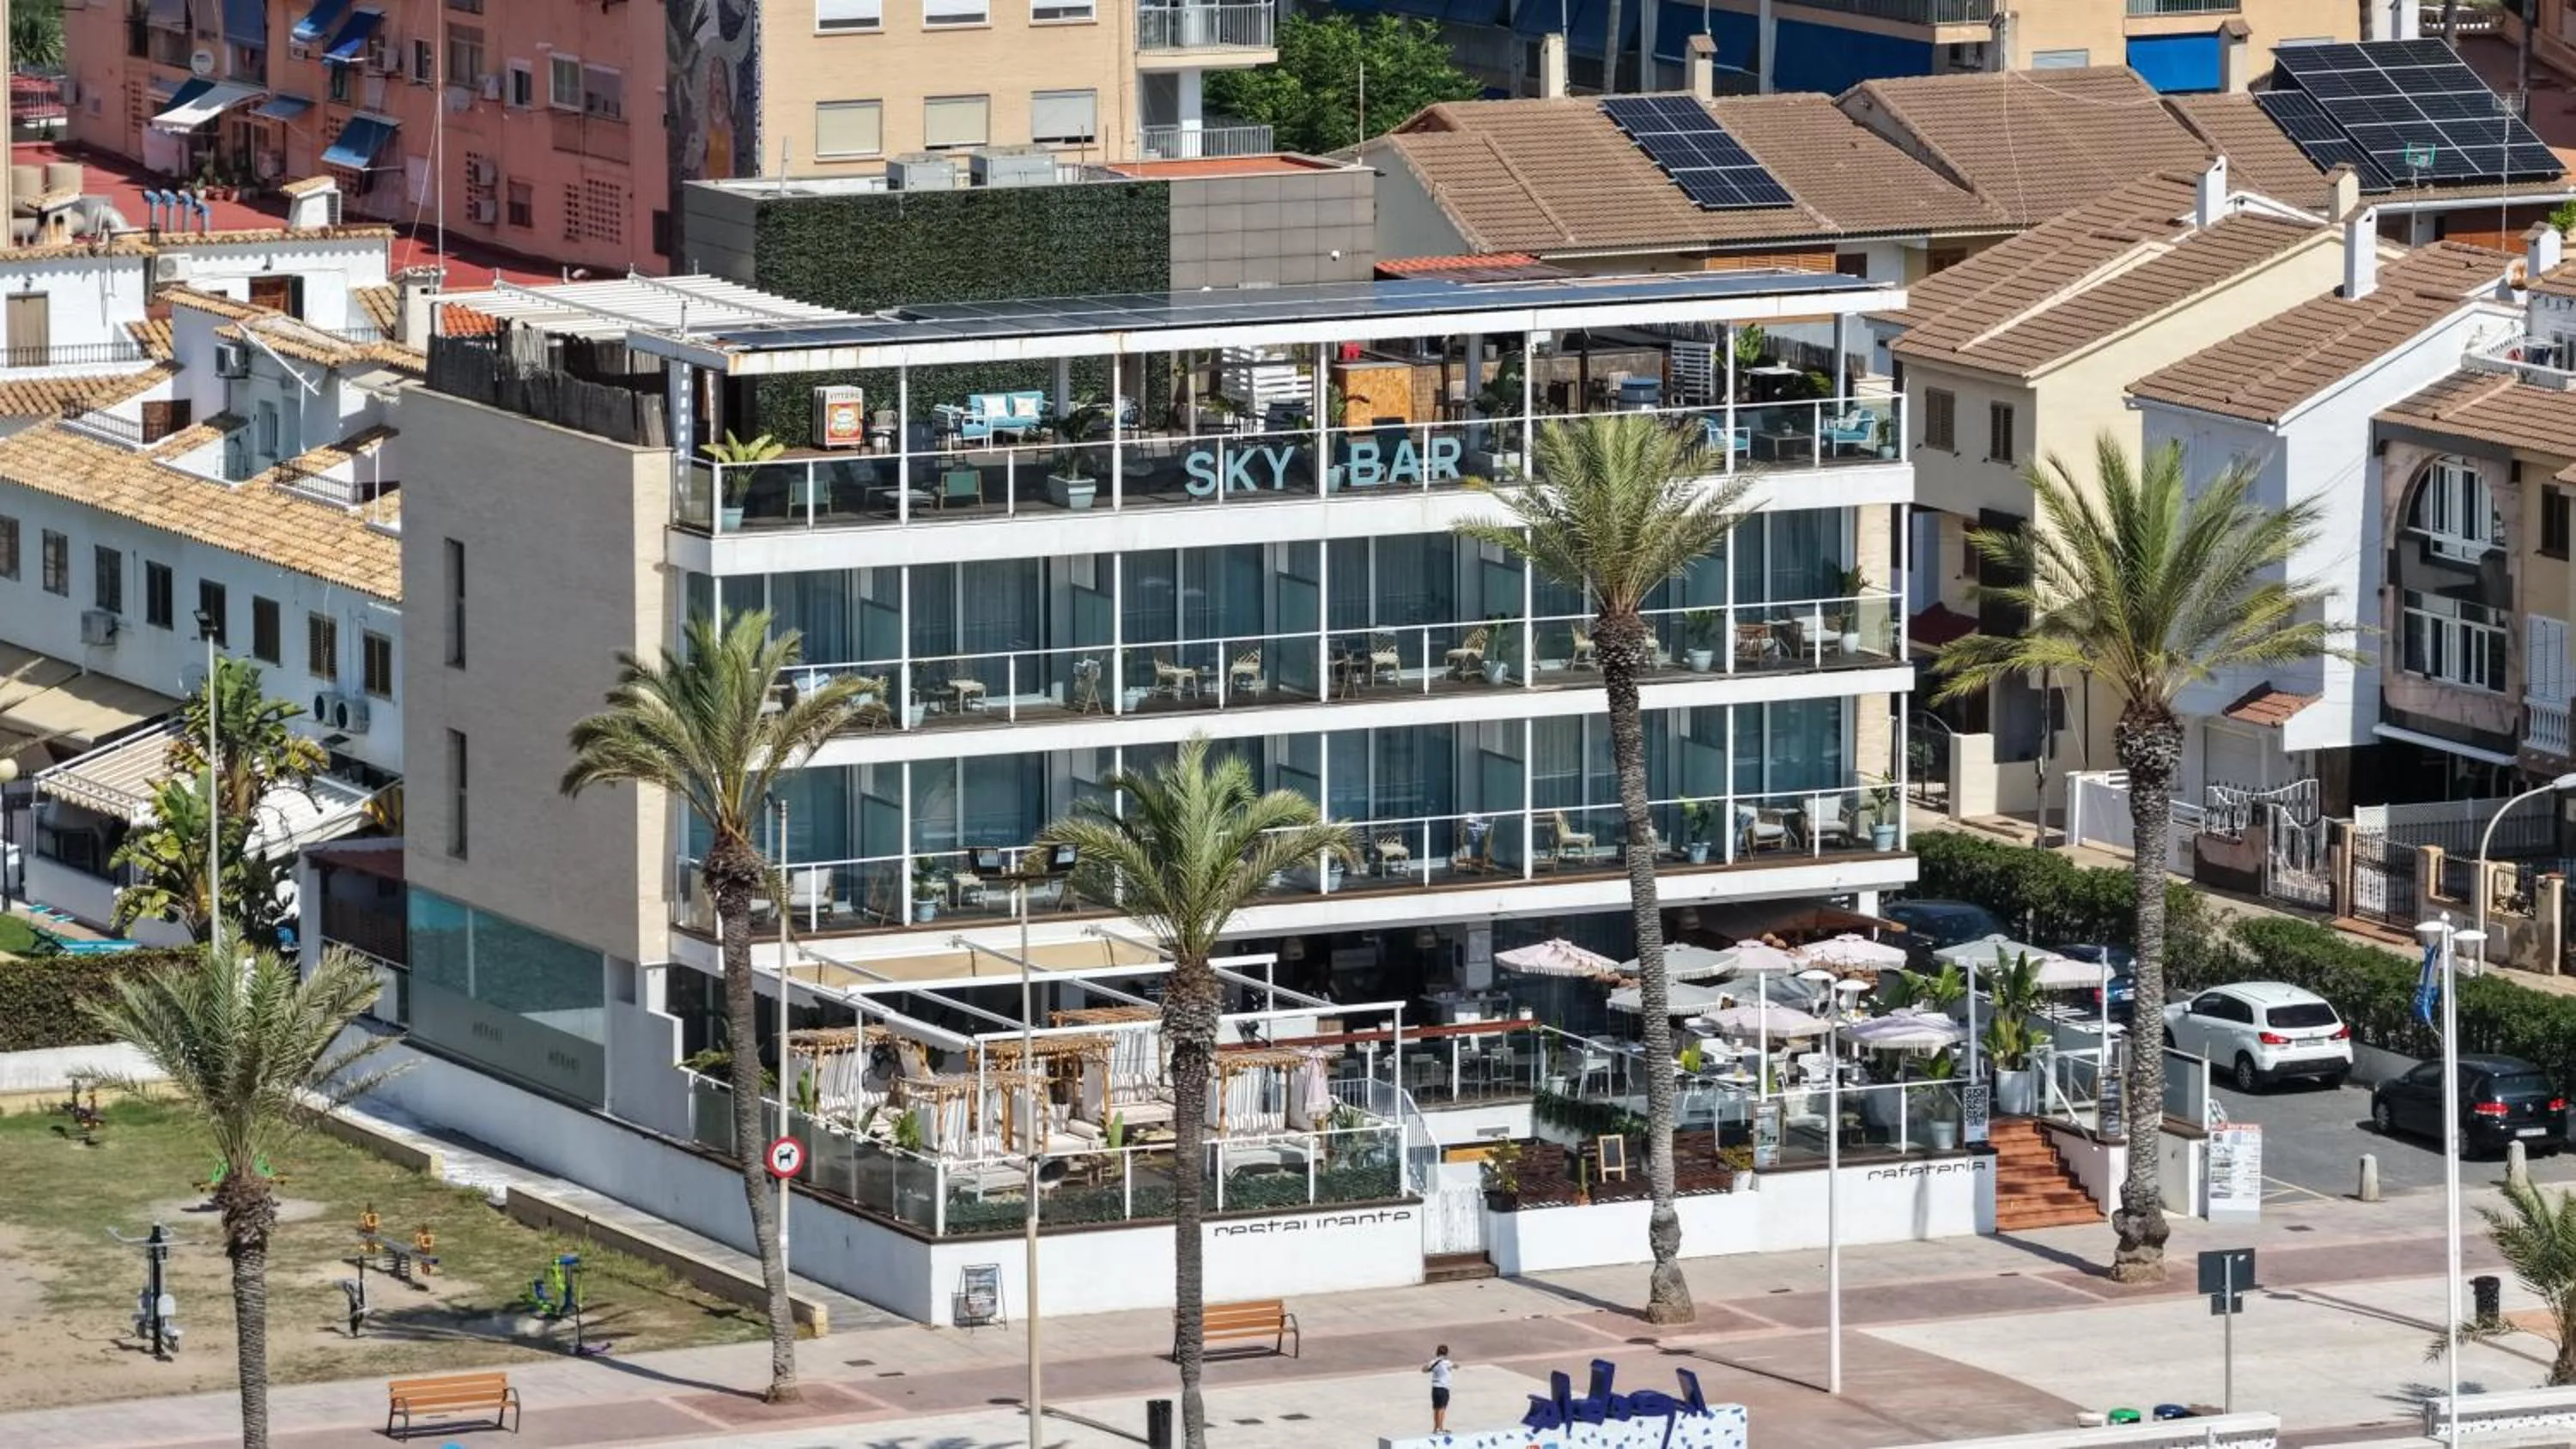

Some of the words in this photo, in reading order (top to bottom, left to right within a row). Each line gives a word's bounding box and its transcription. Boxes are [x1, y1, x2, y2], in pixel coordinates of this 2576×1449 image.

[1184, 445, 1296, 496] SKY
[1348, 436, 1462, 487] BAR
[1213, 1210, 1412, 1237] restaurante
